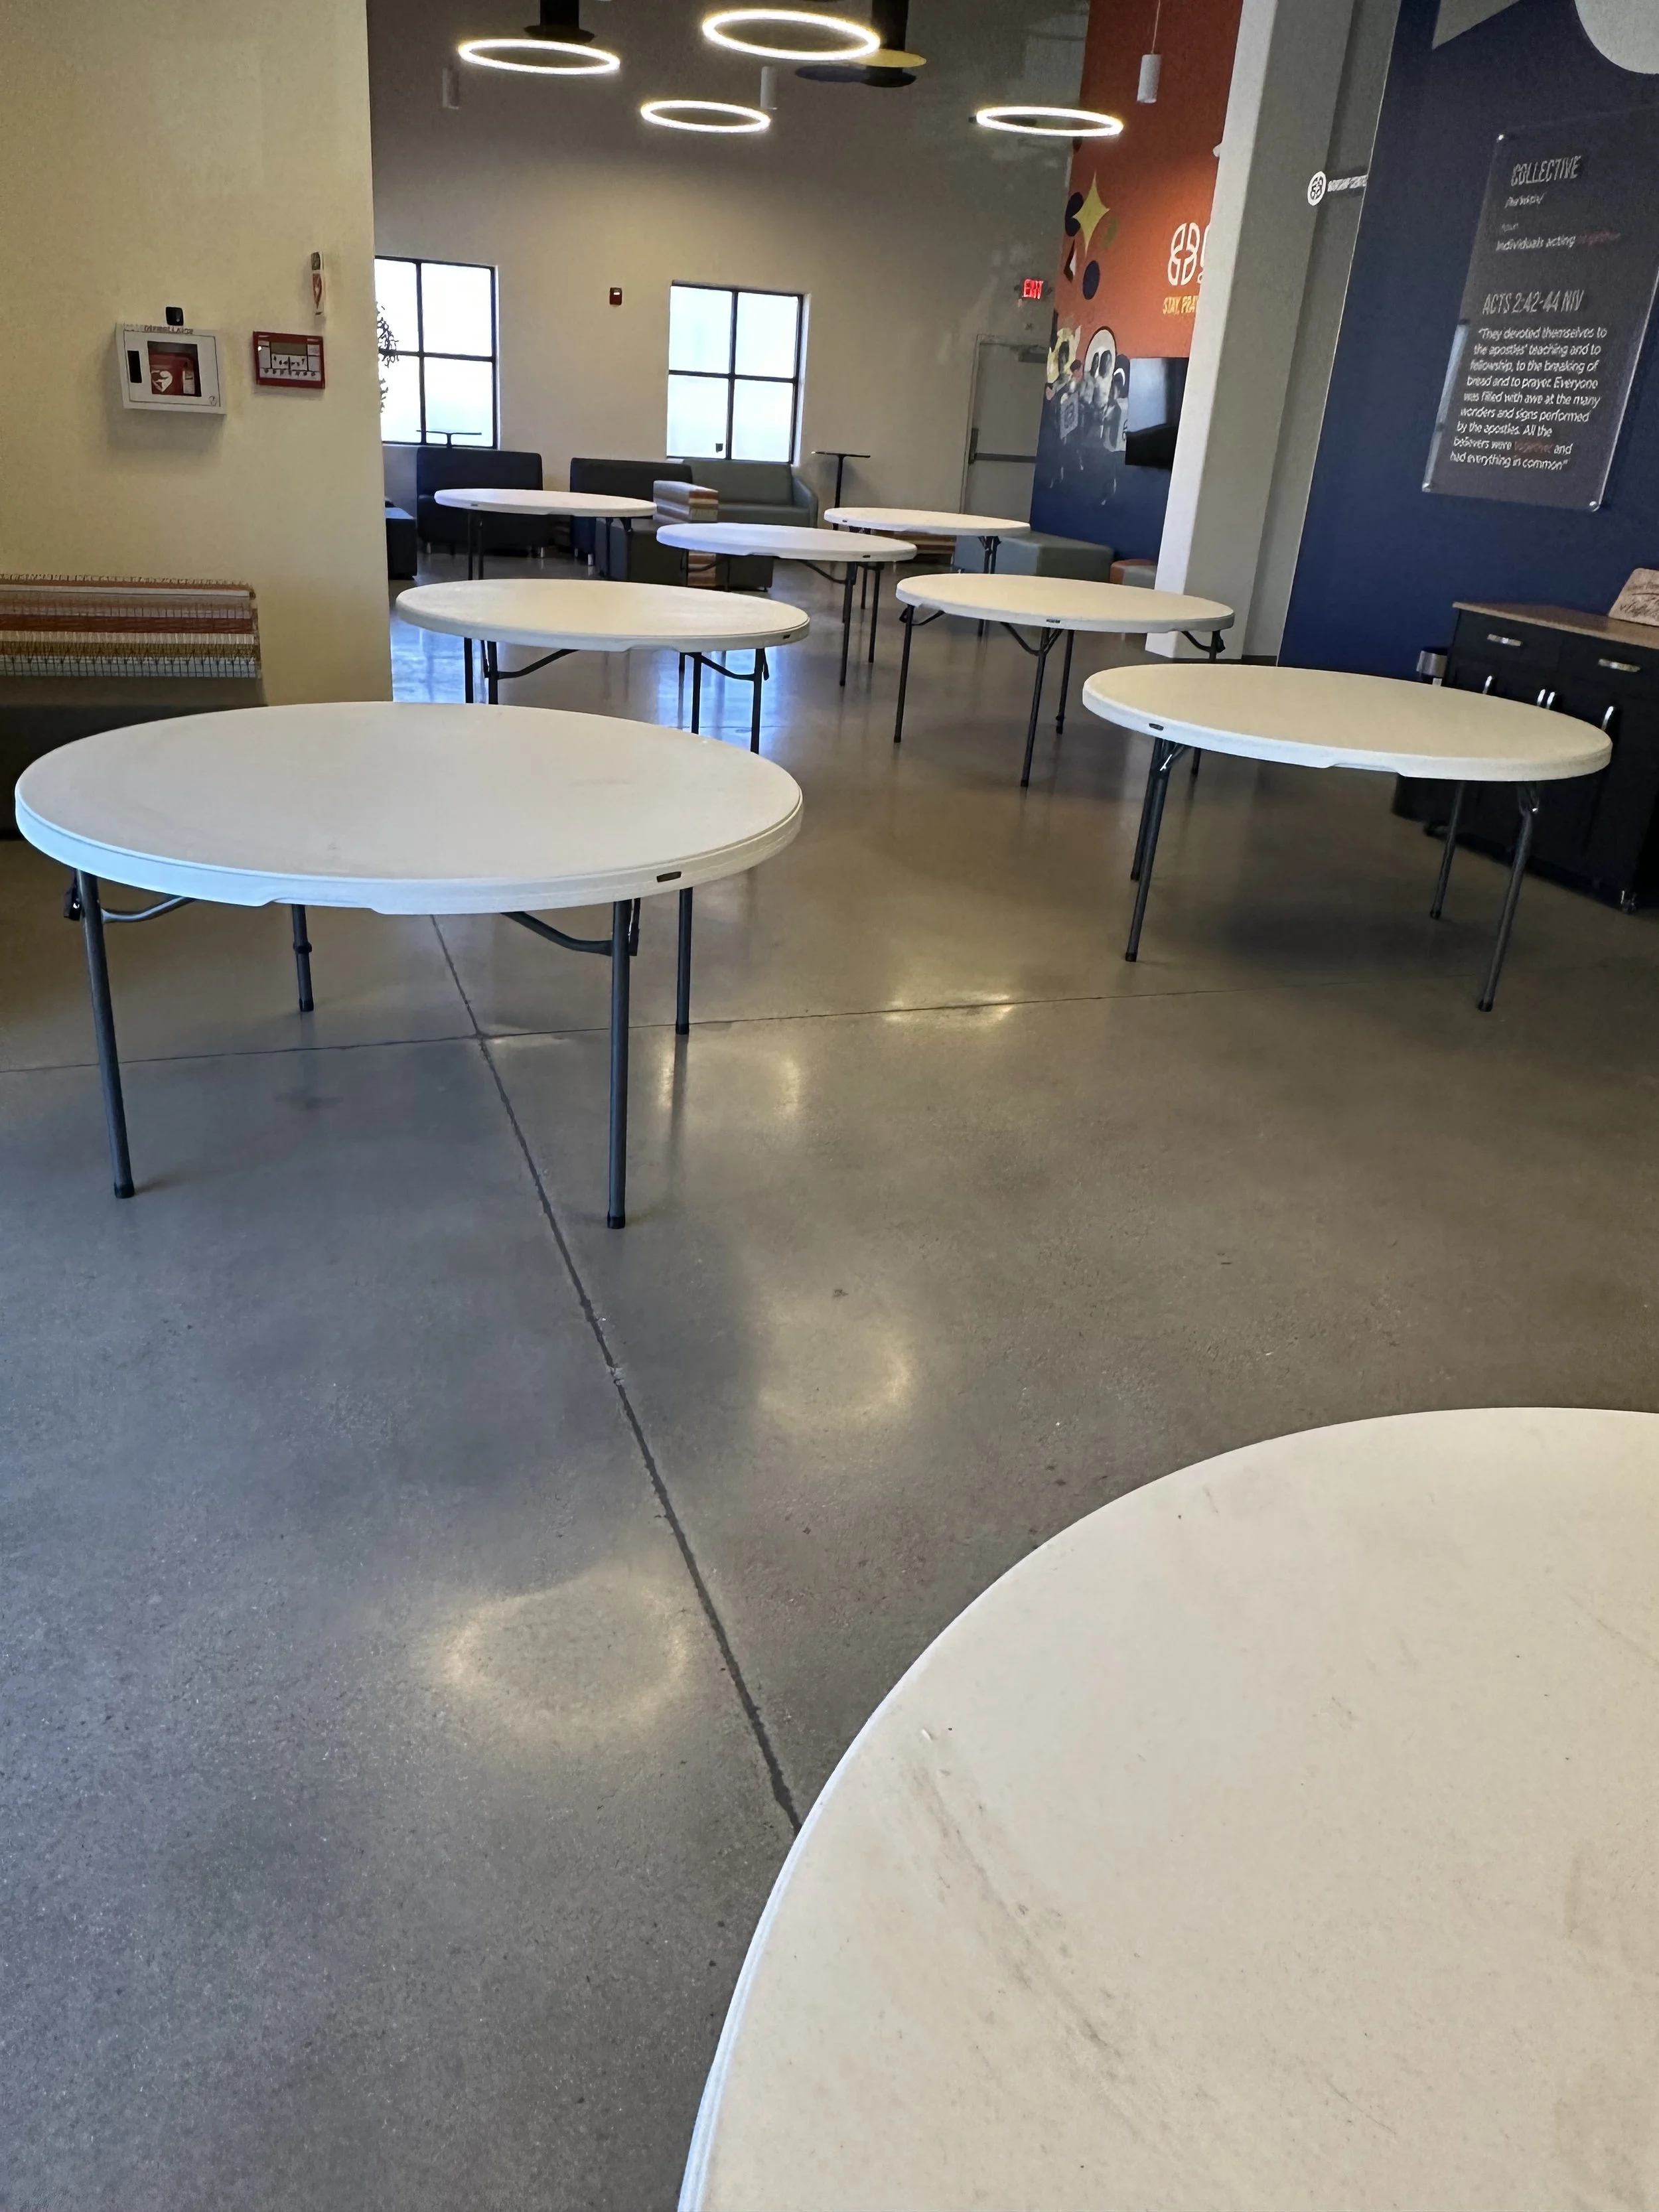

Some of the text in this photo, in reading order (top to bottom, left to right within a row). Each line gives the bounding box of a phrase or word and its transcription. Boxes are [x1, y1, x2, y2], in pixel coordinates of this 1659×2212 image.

[1511, 155, 1581, 186] COLLECTIVE
[1023, 279, 1044, 299] EXIT
[1181, 295, 1199, 314] PRA
[1482, 293, 1512, 315] ACTS
[1561, 289, 1585, 312] NIV
[1503, 327, 1541, 338] devoted
[1542, 326, 1595, 338] themselves
[1597, 326, 1607, 338] to
[1474, 343, 1487, 355] the
[1528, 344, 1568, 358] teaching
[1569, 343, 1590, 355] and
[1591, 344, 1601, 355] to
[1516, 360, 1526, 372] to
[1527, 360, 1542, 372] the
[1544, 360, 1585, 374] breaking
[1587, 359, 1600, 372] of
[1467, 376, 1492, 387] bread
[1493, 376, 1510, 387] and
[1510, 376, 1521, 387] to
[1553, 376, 1599, 390] Everyone
[1464, 391, 1601, 409] was filled with awe at the many
[1461, 407, 1592, 423] wonders and signs performed
[1457, 421, 1467, 433] by
[1469, 421, 1482, 433] the
[1522, 424, 1536, 436] All
[1537, 424, 1553, 437] the
[1453, 436, 1490, 449] believers
[1491, 440, 1512, 451] were
[1553, 443, 1573, 455] and
[1450, 451, 1467, 463] had
[1467, 453, 1512, 469] everything
[1512, 455, 1522, 467] in
